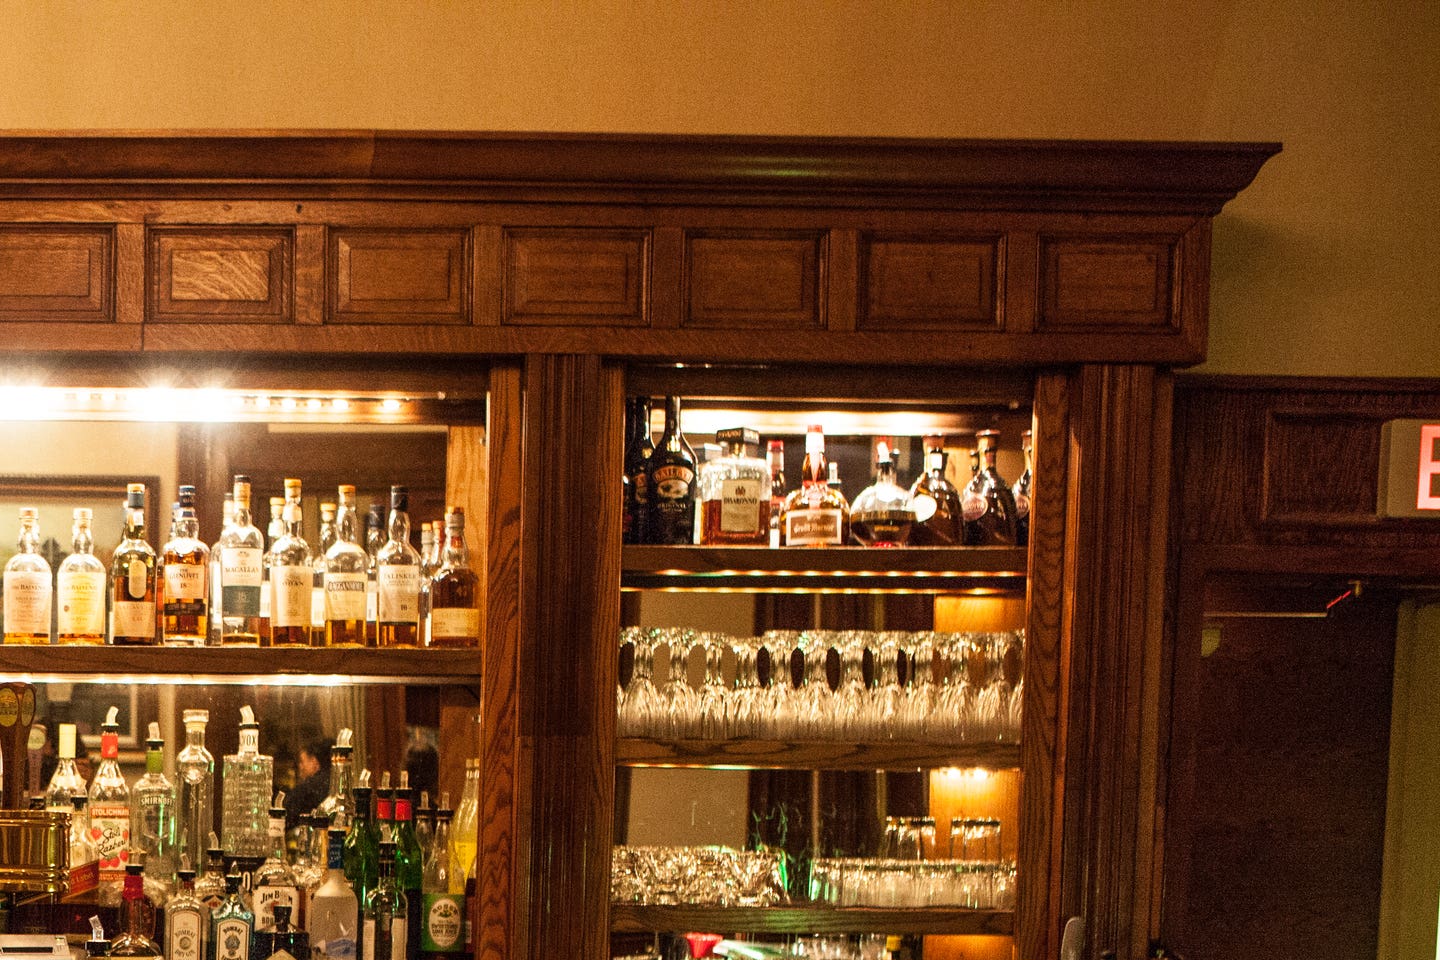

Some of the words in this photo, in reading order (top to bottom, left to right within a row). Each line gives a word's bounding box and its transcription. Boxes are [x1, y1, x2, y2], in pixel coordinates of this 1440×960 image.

[724, 497, 757, 505] DISARONNO
[141, 795, 173, 806] SMIRNOFF
[261, 892, 273, 904] JIM
[274, 890, 293, 905] BM
[174, 929, 196, 939] BOMBAY
[223, 926, 243, 936] BOMBAY
